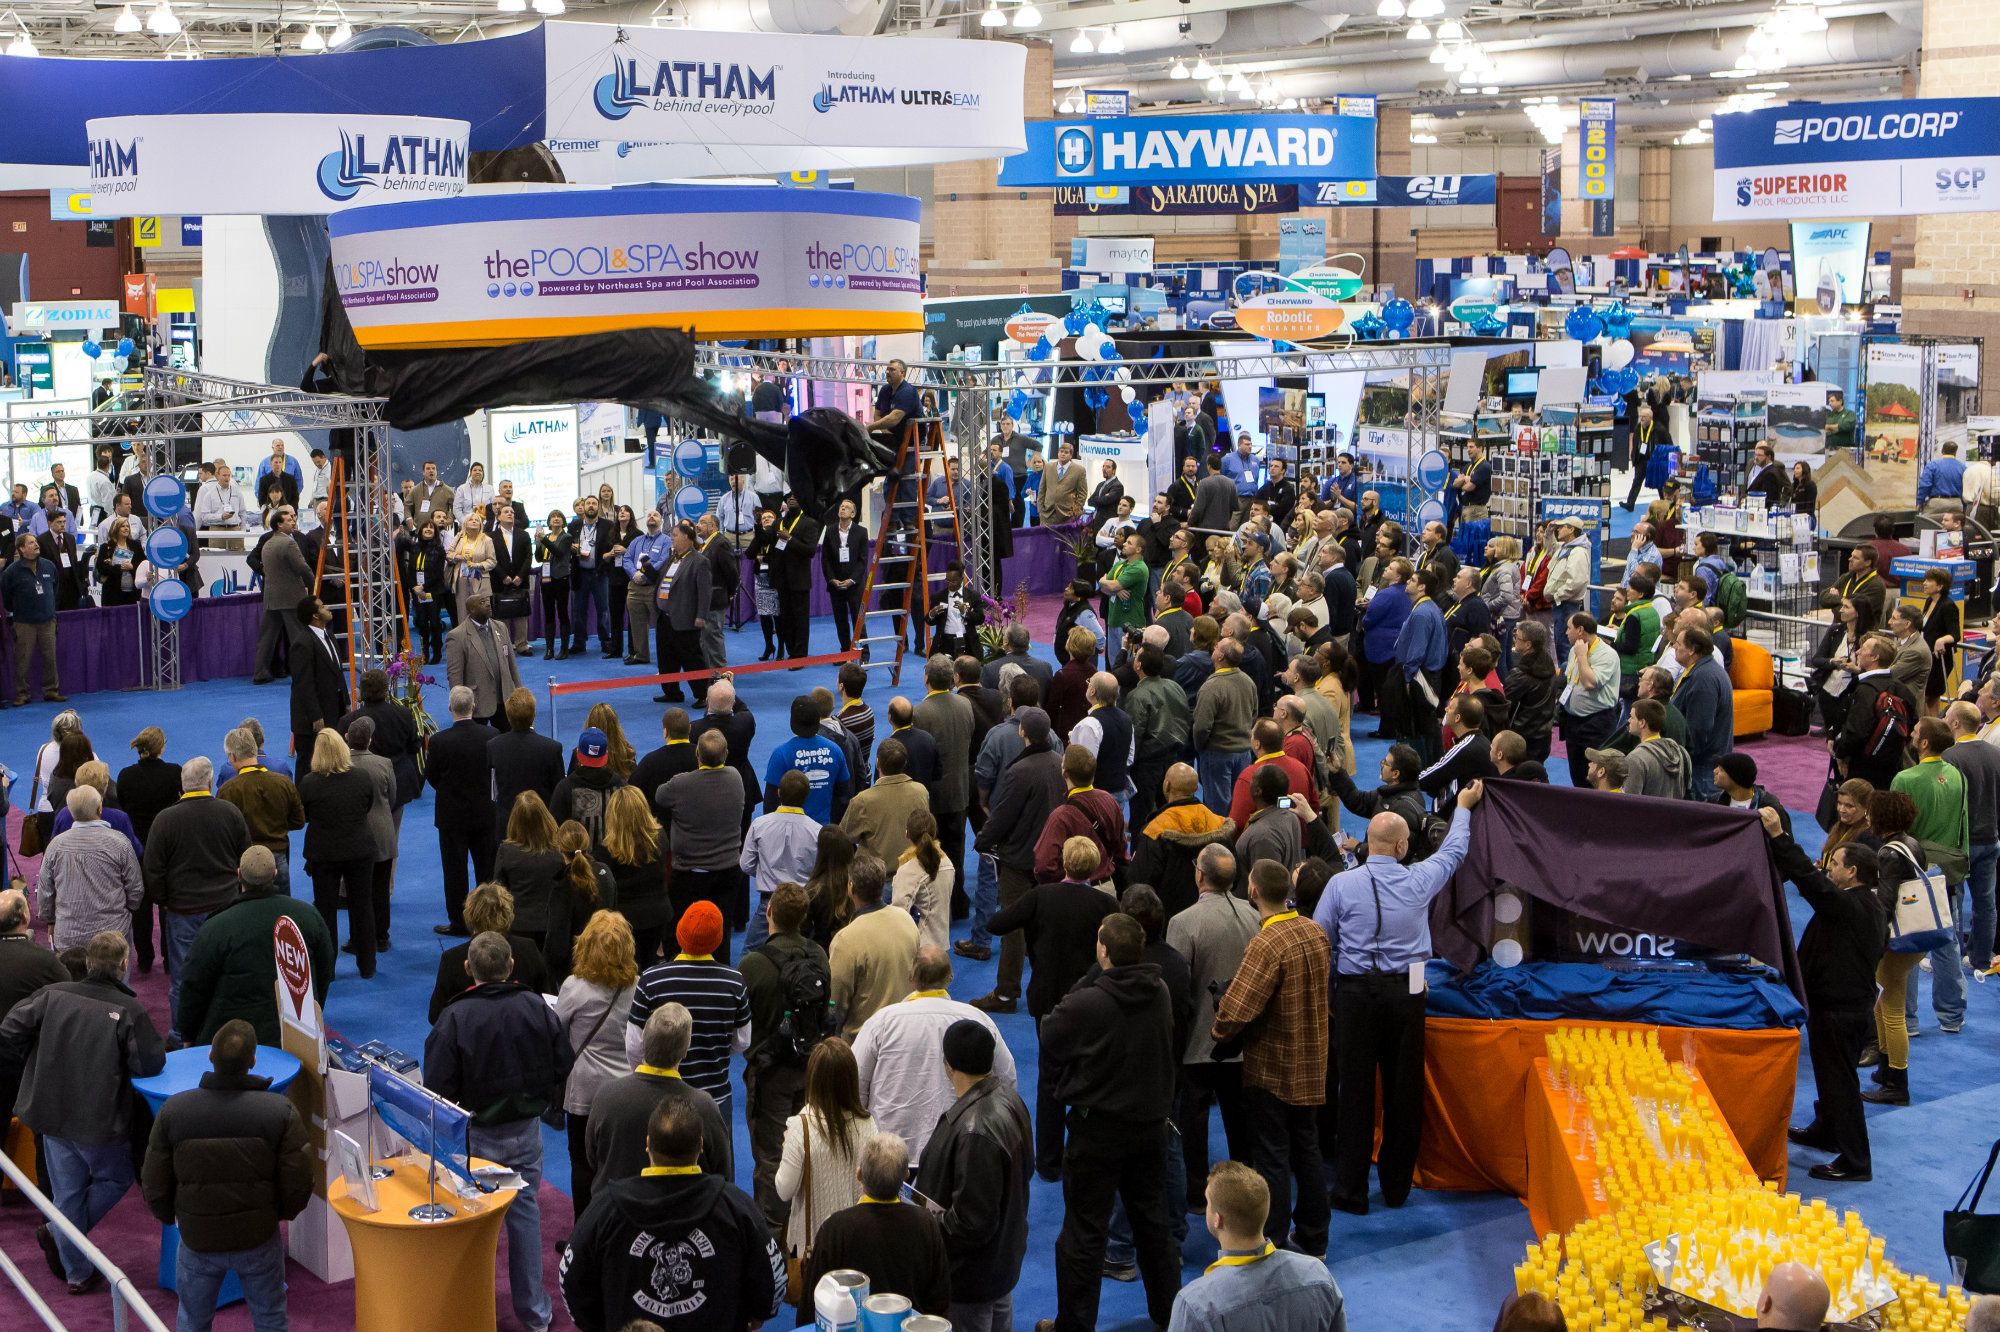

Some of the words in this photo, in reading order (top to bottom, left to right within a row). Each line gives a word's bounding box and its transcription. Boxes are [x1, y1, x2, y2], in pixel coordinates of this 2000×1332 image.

[627, 58, 776, 101] LATHAM
[827, 70, 875, 83] Introducing
[827, 84, 895, 104] LATHAM
[653, 98, 702, 113] behind
[704, 100, 744, 116] every
[743, 102, 776, 117] pool
[1803, 111, 1959, 143] POOLCORP
[355, 133, 467, 178] LATHAM
[1102, 127, 1335, 170] HAYWARD
[1586, 130, 1606, 195] 2000
[114, 177, 138, 196] pool
[383, 175, 427, 191] behind
[428, 182, 453, 196] every
[1406, 175, 1462, 200] GLI
[1753, 173, 1848, 196] SUPERIOR
[1935, 167, 1986, 190] SCP
[1151, 184, 1239, 213] SARATOGA
[1243, 182, 1278, 211] SPA
[1753, 198, 1774, 207] POOL
[1776, 195, 1827, 206] PRODUCTS
[1830, 194, 1849, 204] LLC
[1824, 228, 1849, 239] APC
[334, 256, 440, 291] OOL&SPAshow
[542, 281, 581, 295] powered
[583, 282, 595, 292] by
[597, 279, 643, 291] Northeast
[646, 280, 663, 290] Spa
[665, 278, 682, 288] and
[685, 278, 705, 287] Pool
[707, 276, 757, 287] Association
[850, 280, 875, 288] powered
[875, 280, 881, 289] by
[366, 294, 375, 305] Spa
[375, 293, 386, 302] and
[386, 292, 399, 301] Pool
[400, 290, 436, 300] Association
[45, 308, 113, 321] ZODIAC
[1266, 310, 1313, 324] Robotic
[518, 420, 569, 435] LATHAM
[498, 447, 535, 469] CASH
[1083, 446, 1121, 456] HAYWARD
[1385, 510, 1400, 520] Pool
[1545, 503, 1600, 517] PEPPER
[795, 757, 812, 767] Pool
[817, 755, 834, 765] Spa
[796, 747, 831, 759] Glamour
[275, 936, 306, 973] NEW
[636, 1294, 703, 1316] CALIFORNIA
